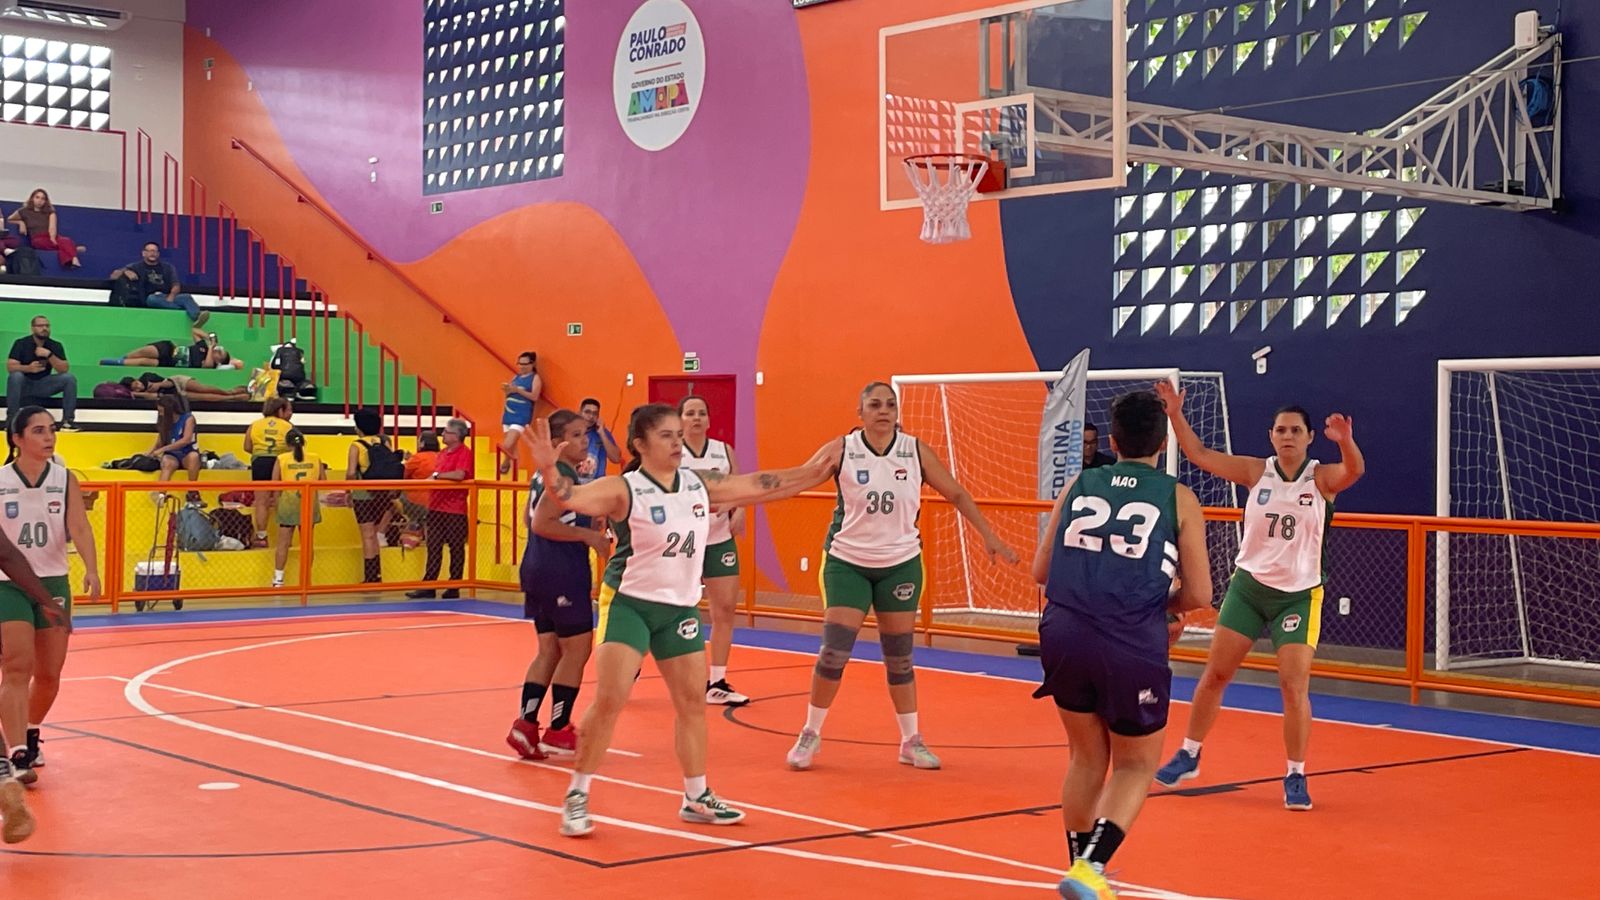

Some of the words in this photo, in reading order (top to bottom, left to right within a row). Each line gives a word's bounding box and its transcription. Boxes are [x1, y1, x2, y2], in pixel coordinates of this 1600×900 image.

[629, 37, 686, 62] CONRADO
[630, 26, 667, 48] PAULO
[631, 78, 656, 89] GOVERNO
[656, 76, 665, 85] DO
[665, 72, 685, 83] ESTADO
[1110, 475, 1138, 488] MAO
[866, 490, 895, 515] 36
[17, 521, 48, 549] 40
[1063, 495, 1161, 559] 23
[1265, 512, 1296, 541] 78
[661, 530, 696, 558] 24
